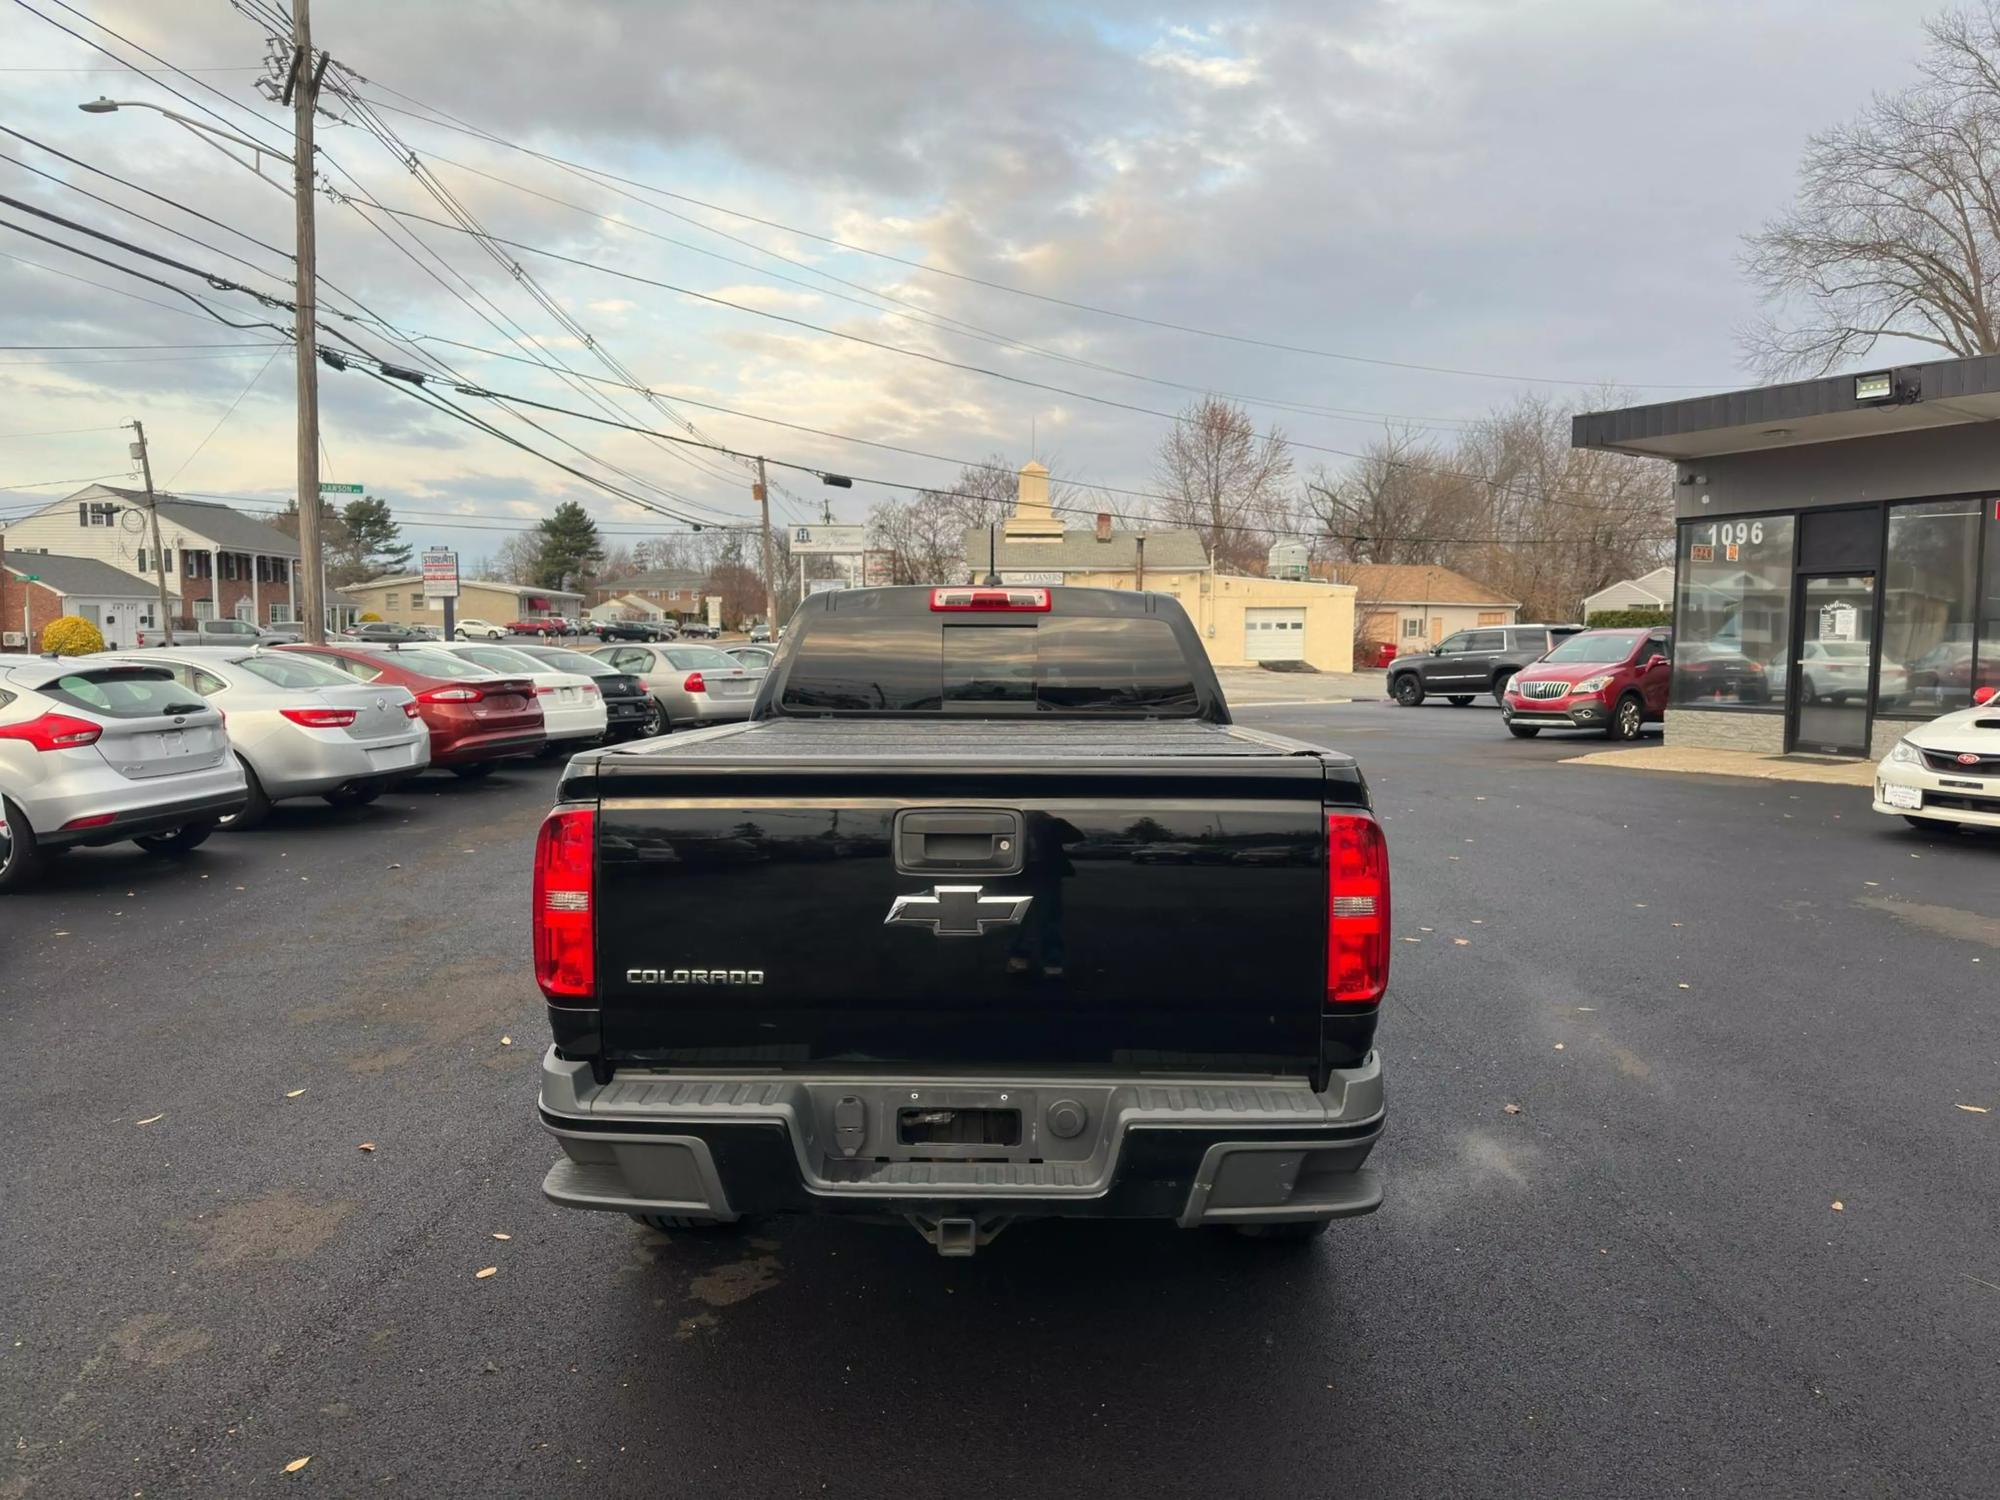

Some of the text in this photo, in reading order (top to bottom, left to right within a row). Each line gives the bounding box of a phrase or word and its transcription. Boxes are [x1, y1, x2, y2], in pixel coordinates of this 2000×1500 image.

[321, 484, 352, 493] DAWSON
[1708, 521, 1764, 546] 1096
[626, 969, 765, 985] COLORADO
